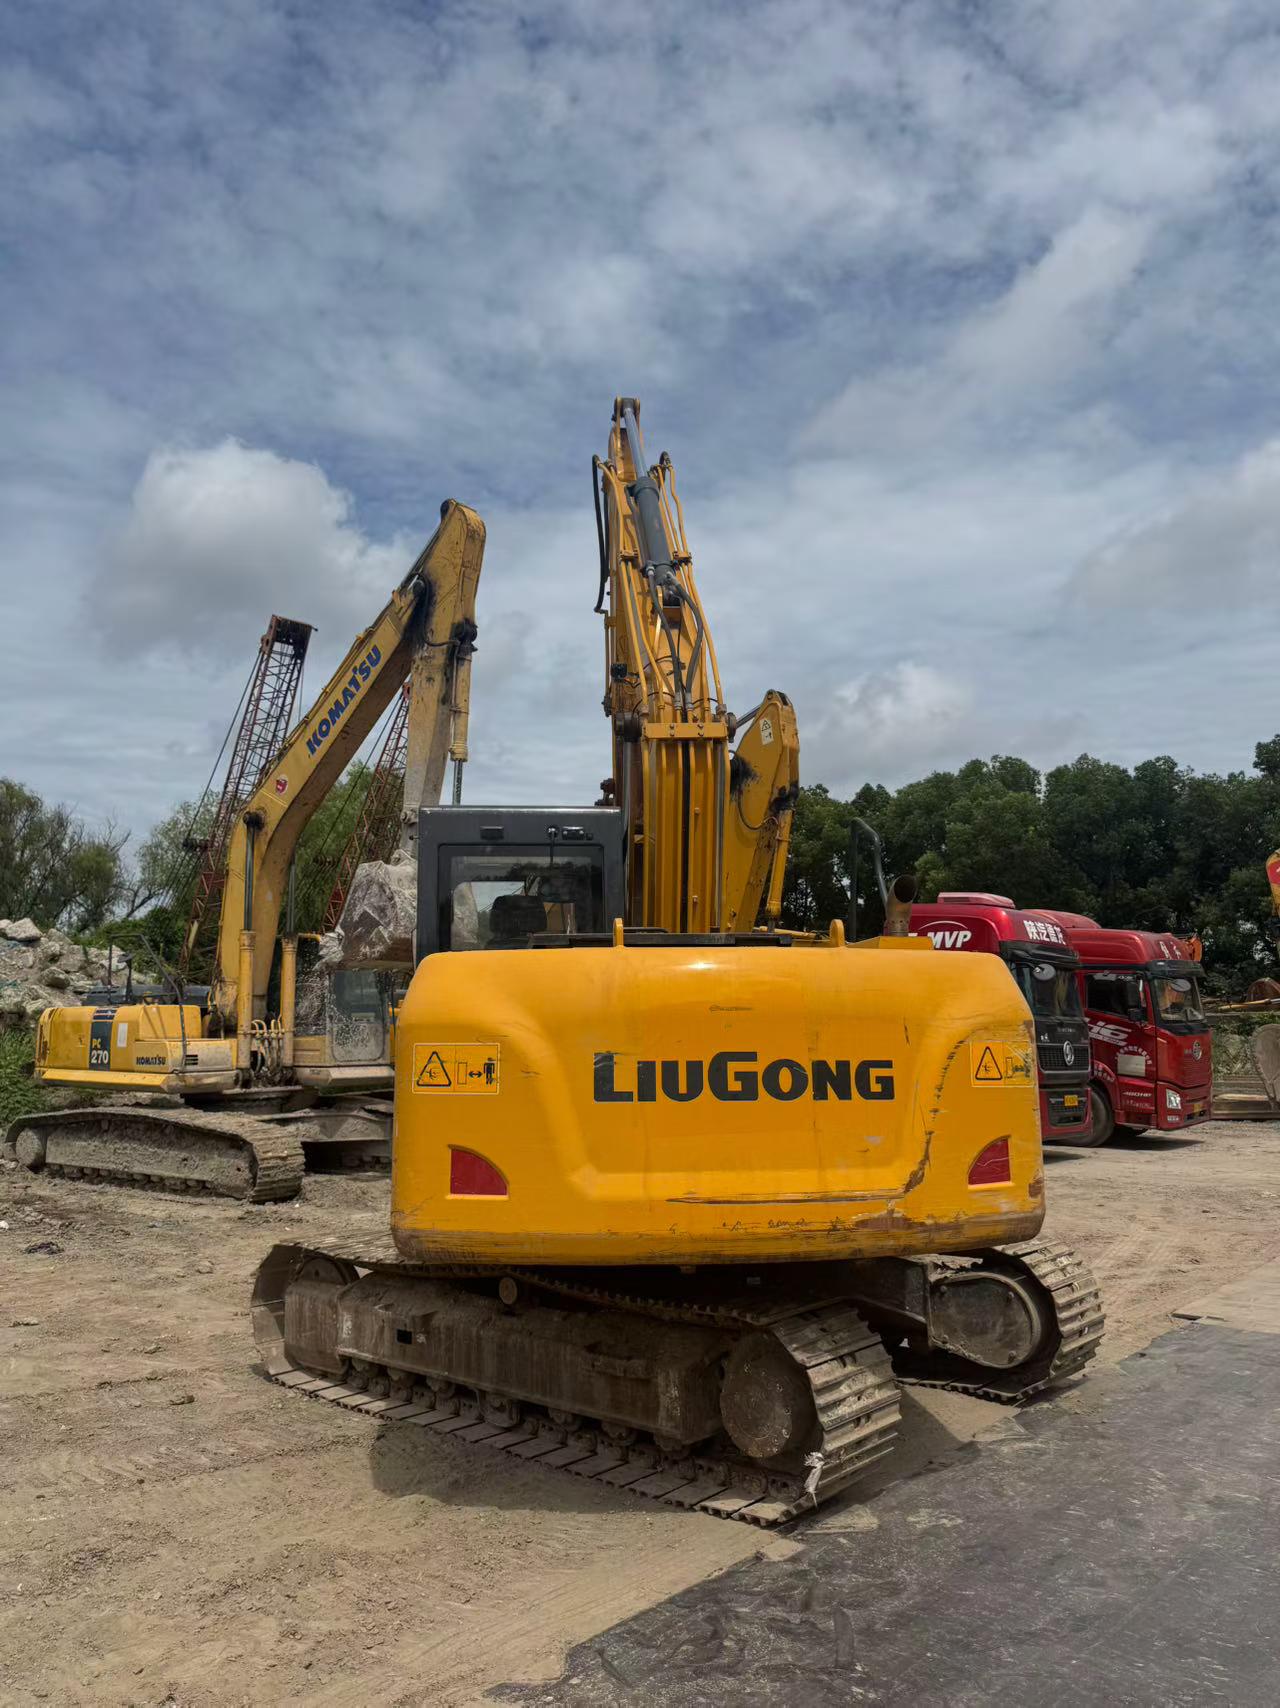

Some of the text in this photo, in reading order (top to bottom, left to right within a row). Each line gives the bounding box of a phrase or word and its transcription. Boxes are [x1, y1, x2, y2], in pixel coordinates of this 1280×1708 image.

[305, 644, 382, 755] KOMATSU
[928, 931, 972, 949] MVP
[92, 1038, 101, 1048] PC
[90, 1049, 109, 1064] 270
[136, 1054, 166, 1066] KOMATSU
[593, 1051, 895, 1103] LIUGONG
